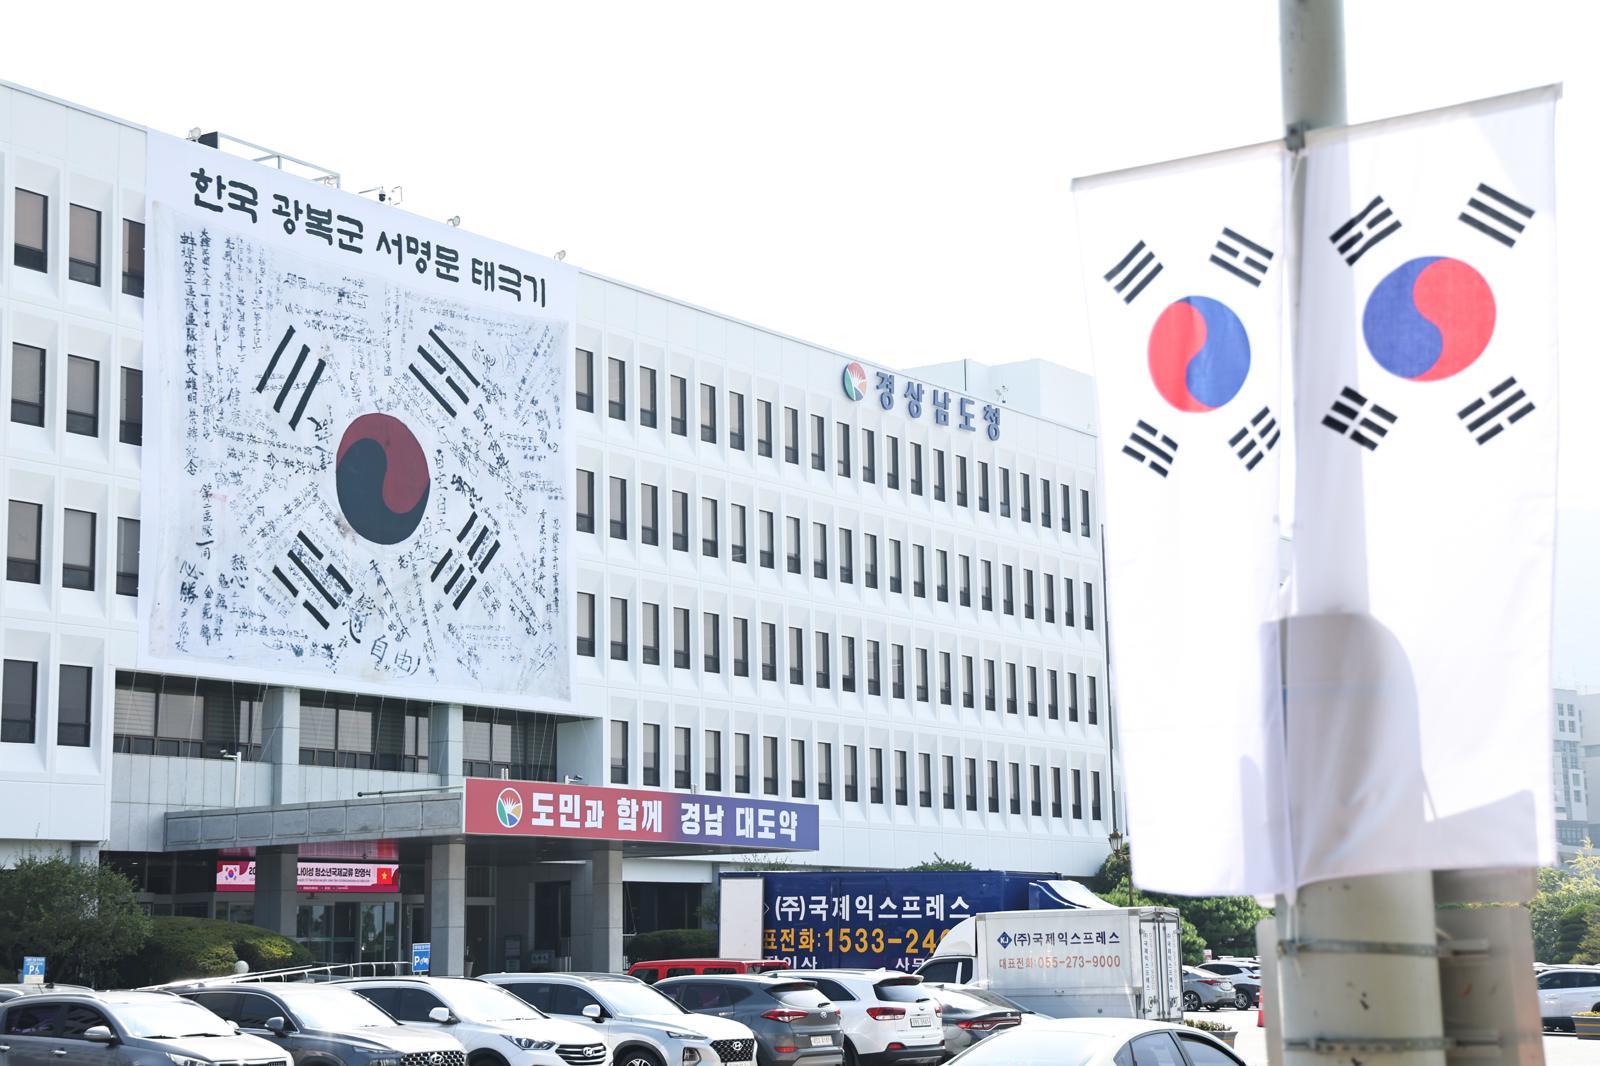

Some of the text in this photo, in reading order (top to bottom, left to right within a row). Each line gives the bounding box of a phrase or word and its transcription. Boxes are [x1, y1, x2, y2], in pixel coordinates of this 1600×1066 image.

[190, 167, 546, 308] 한국 광복군 서명문 태극기
[876, 371, 1001, 441] 경상남도청
[531, 792, 798, 842] 도민과 함께 경남 대도약
[775, 894, 971, 922] (주)국제익스프레스
[1013, 931, 1120, 947] (주)국제익스프레스
